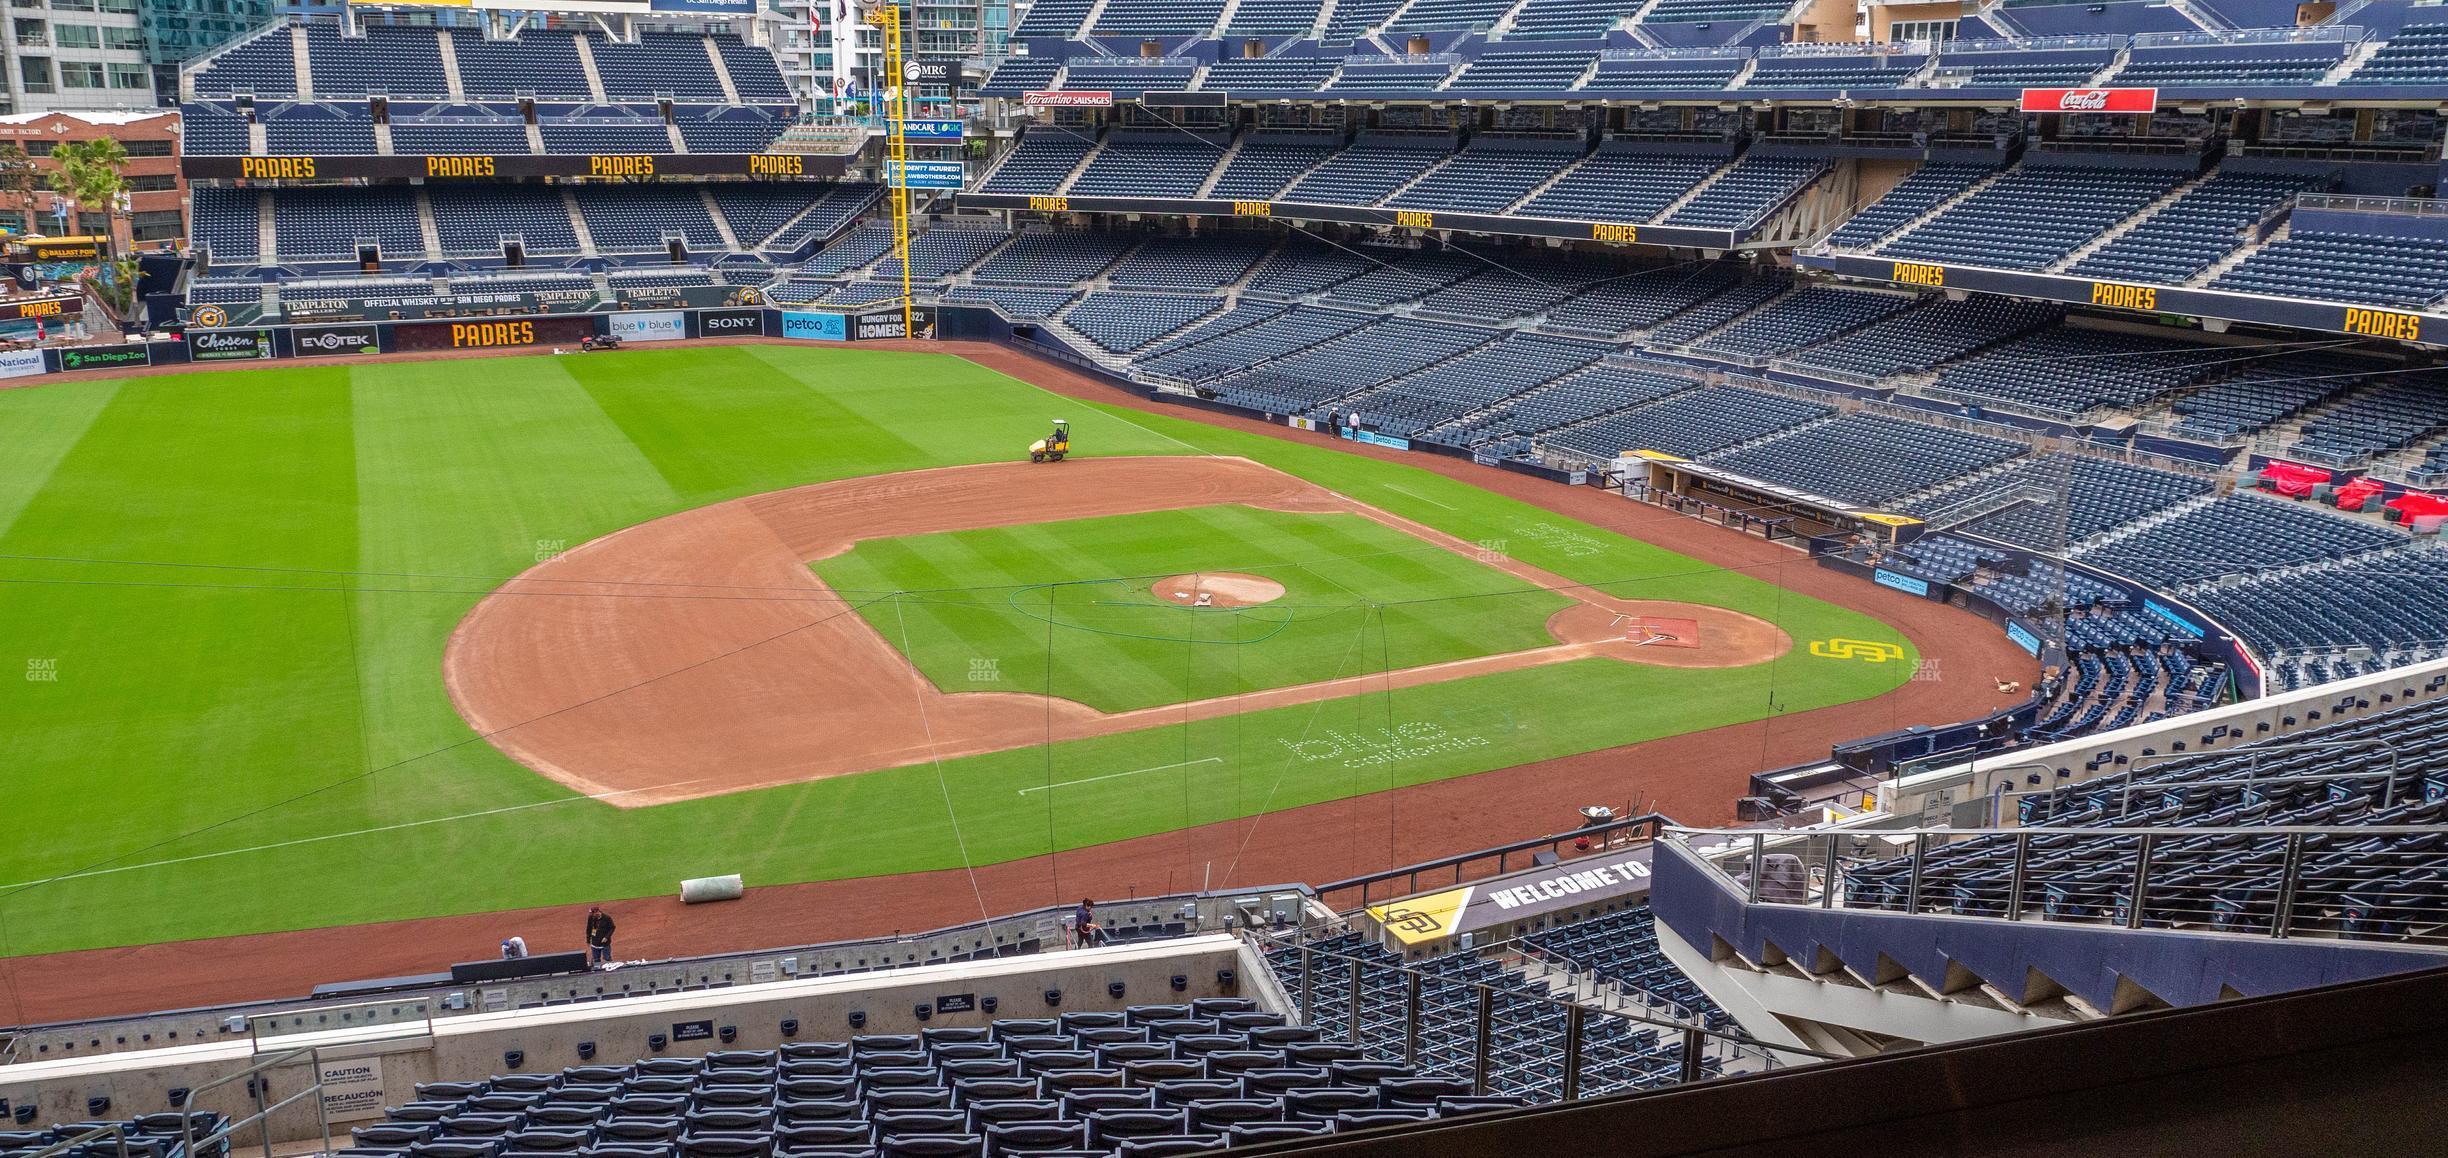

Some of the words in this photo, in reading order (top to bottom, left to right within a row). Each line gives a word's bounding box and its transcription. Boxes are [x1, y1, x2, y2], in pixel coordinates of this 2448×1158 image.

[921, 65, 947, 75] MRC
[1025, 92, 1073, 105] Tarantino
[1072, 96, 1110, 105] SAUSAGES
[937, 123, 961, 132] LOGIC
[241, 157, 315, 178] PADRES
[427, 156, 495, 177] PADRES
[591, 155, 654, 175] PADRES
[750, 155, 803, 175] PADRES
[1029, 196, 1068, 211] PADRES
[1234, 202, 1271, 216] PADRES
[1397, 211, 1432, 228] PADRES
[1593, 223, 1636, 243] PADRES
[49, 249, 79, 257] BALLAST
[1893, 262, 1944, 287] PADRES
[534, 291, 592, 301] TEMPLETON
[625, 288, 681, 298] TEMPLETON
[2092, 282, 2156, 310] PADRES
[284, 299, 349, 311] TEMPLETON
[364, 299, 401, 308] OFFICIAL
[402, 297, 438, 306] WHISKEY
[457, 295, 472, 304] SAN
[473, 295, 493, 303] DIEGO
[495, 294, 521, 303] PADRES
[20, 301, 62, 317] PADRES
[708, 318, 756, 329] SONY
[861, 314, 888, 323] HUNGRY
[889, 314, 903, 322] FOR
[910, 311, 925, 322] 322
[612, 322, 635, 331] blue
[649, 320, 672, 330] blue
[786, 318, 823, 331] petco
[859, 323, 906, 338] HOMERS
[2344, 308, 2421, 341] PADRES
[197, 333, 254, 348] Chosen
[301, 333, 370, 350] EVOTEK
[452, 321, 534, 348] PADRES
[0, 355, 40, 368] National
[84, 353, 101, 362] San
[102, 352, 127, 362] Diego
[128, 351, 146, 359] Zoo
[1375, 435, 1392, 445] petco
[1876, 570, 1901, 585] petco
[2009, 623, 2024, 641] petco
[1277, 721, 1447, 762] blue
[1488, 867, 1619, 910] WELCOME
[1611, 860, 1651, 882] TO
[324, 1066, 371, 1078] CAUTION
